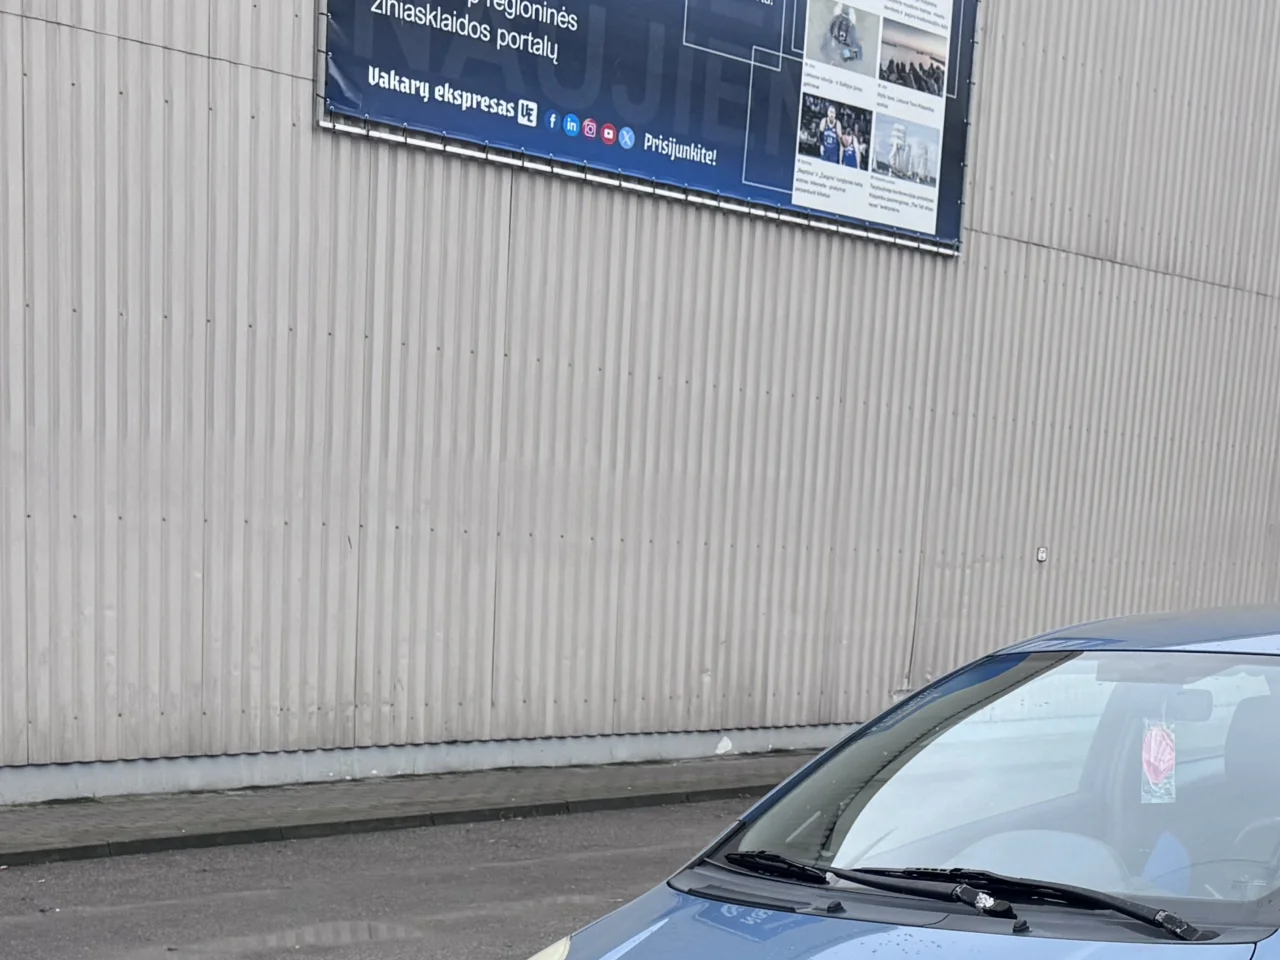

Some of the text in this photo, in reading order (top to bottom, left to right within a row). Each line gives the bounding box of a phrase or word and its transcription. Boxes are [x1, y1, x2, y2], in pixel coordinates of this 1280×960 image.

[497, 28, 558, 65] portalų
[434, 82, 515, 117] ekspresas
[643, 132, 718, 166] Prisijunkite!
